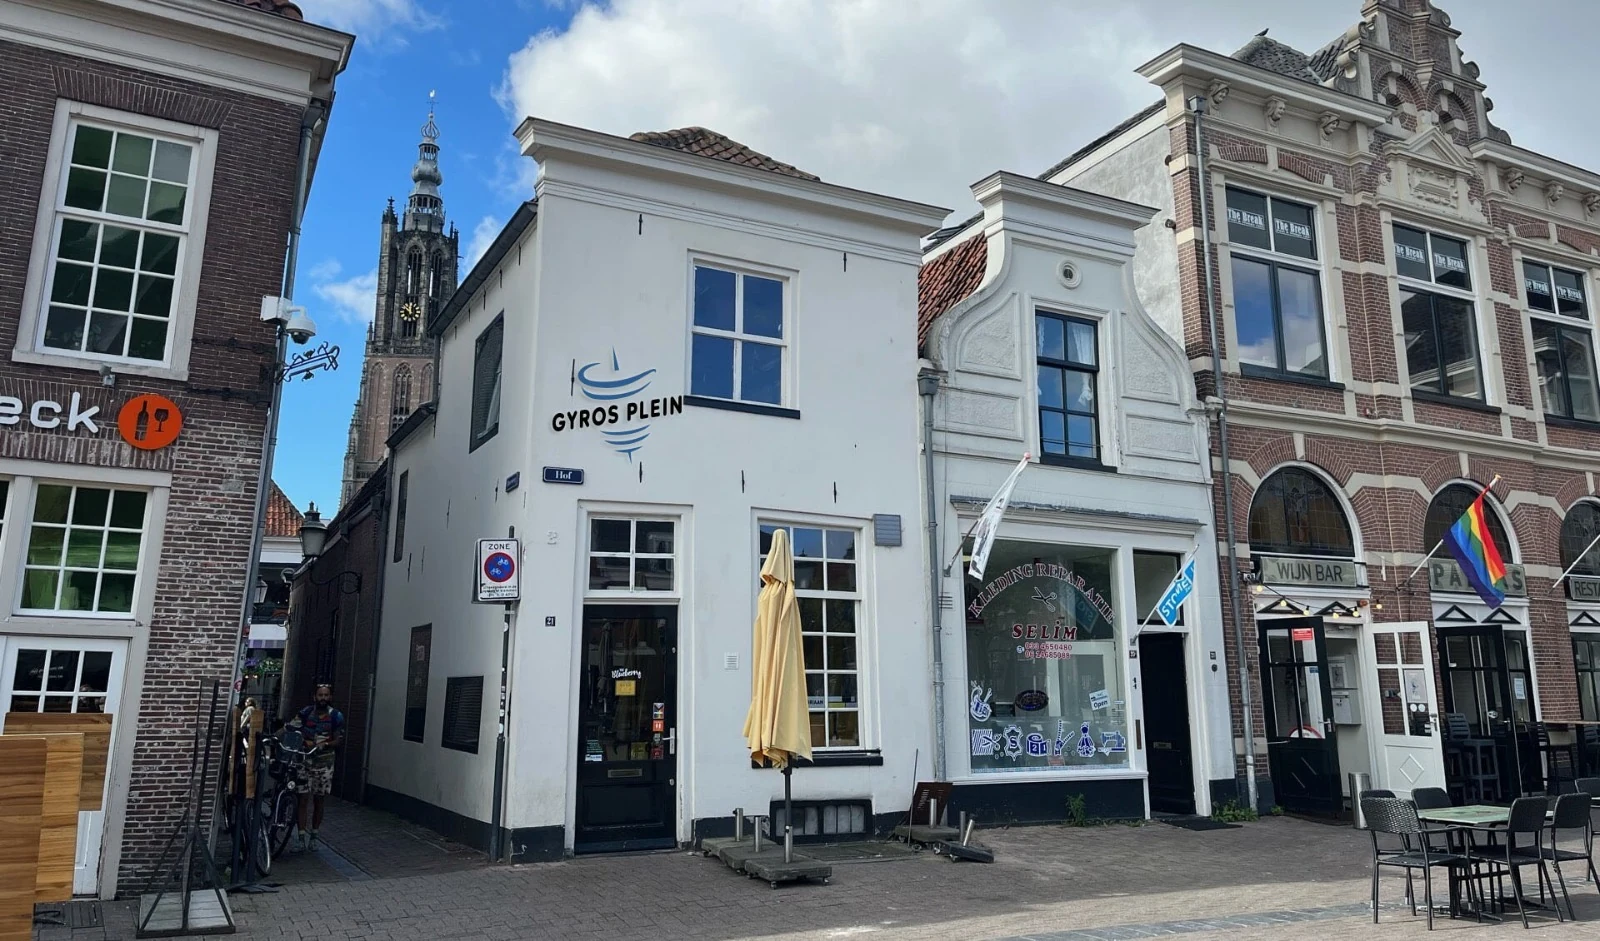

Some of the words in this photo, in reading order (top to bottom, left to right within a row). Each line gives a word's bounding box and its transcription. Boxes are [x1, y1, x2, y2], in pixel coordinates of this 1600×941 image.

[1228, 208, 1240, 220] The
[1242, 210, 1263, 225] Break
[1276, 220, 1288, 232] The
[1290, 222, 1310, 236] Break
[1394, 245, 1404, 256] he
[1405, 246, 1424, 260] Break
[1434, 253, 1446, 264] The
[1446, 256, 1464, 268] Break
[552, 404, 618, 432] GYROS
[627, 396, 682, 421] PLEIN
[556, 471, 572, 480] Hof
[1276, 562, 1312, 581] WIJN
[1316, 564, 1343, 582] BAR
[968, 564, 1034, 618] KLEDING
[1036, 563, 1116, 625] REPARATIE
[1094, 700, 1108, 709] Open
